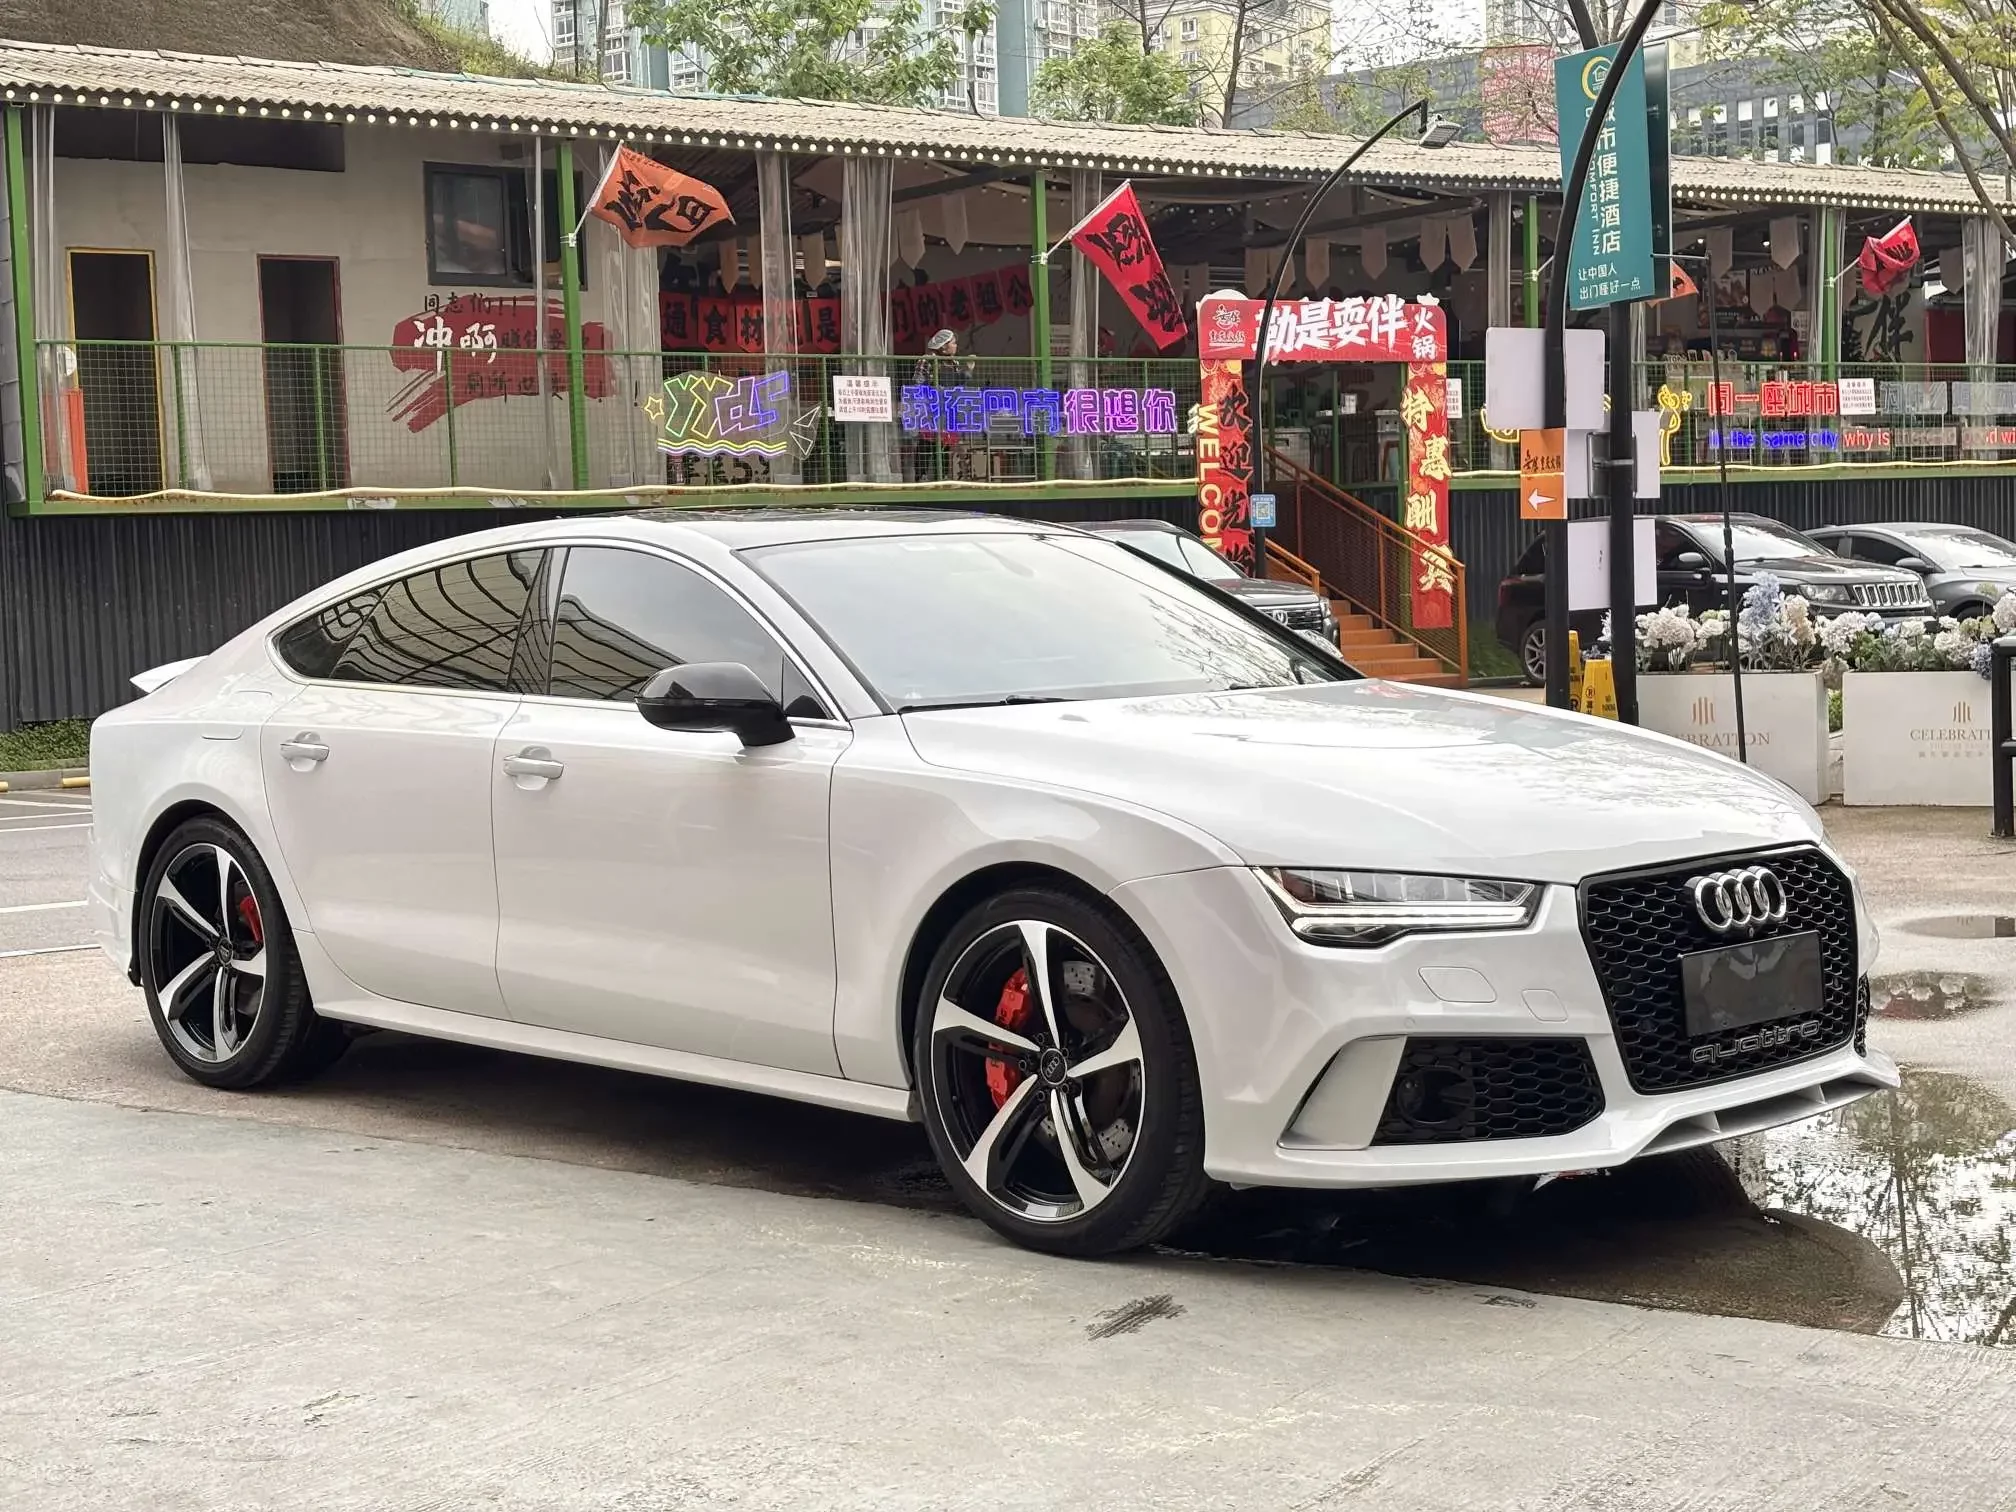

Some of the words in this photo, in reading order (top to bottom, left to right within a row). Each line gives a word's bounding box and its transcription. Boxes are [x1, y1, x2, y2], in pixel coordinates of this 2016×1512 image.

[1588, 153, 1599, 221] OMFORT
[1591, 228, 1600, 256] INN
[1578, 263, 1617, 280] 让中国人
[413, 316, 498, 375] 冲啊
[1412, 307, 1438, 359] 火锅
[901, 385, 1177, 434] 我在巴南很想你
[1708, 382, 1838, 415] 同一座城市
[1762, 432, 1806, 448] same
[1845, 430, 1873, 450] why
[1878, 427, 1890, 445] is
[1679, 732, 1769, 747] BRATION
[1692, 1019, 1820, 1064] quattro
